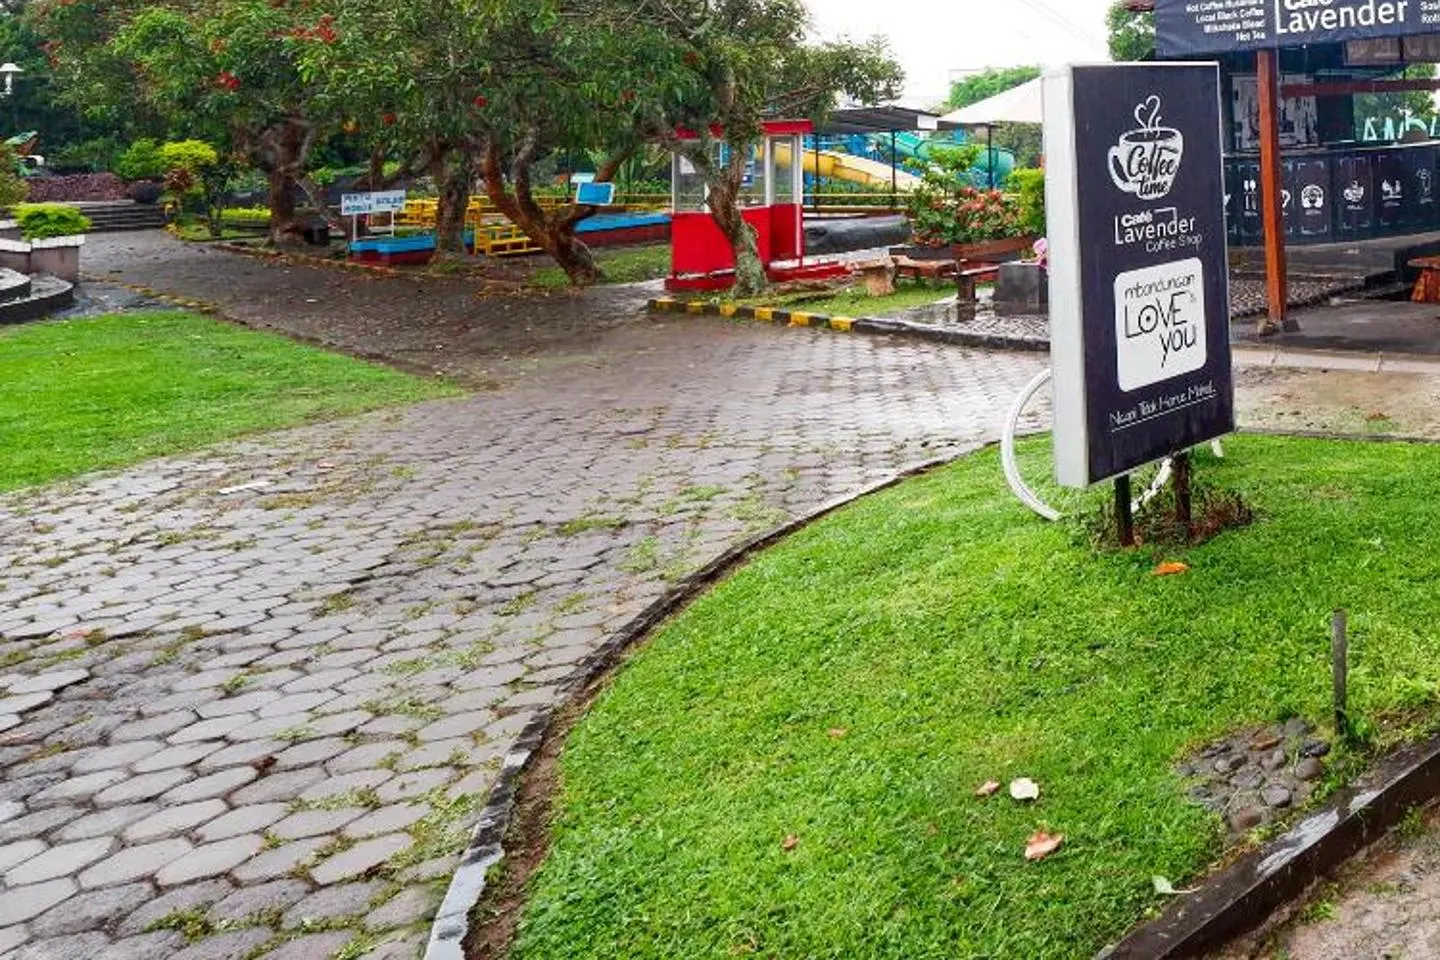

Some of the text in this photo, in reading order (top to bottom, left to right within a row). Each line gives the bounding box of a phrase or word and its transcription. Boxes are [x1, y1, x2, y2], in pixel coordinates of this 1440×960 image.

[1127, 143, 1179, 181] Coffee
[1115, 207, 1195, 245] Lavender
[1121, 209, 1154, 228] Café
[1146, 238, 1176, 253] Coffee
